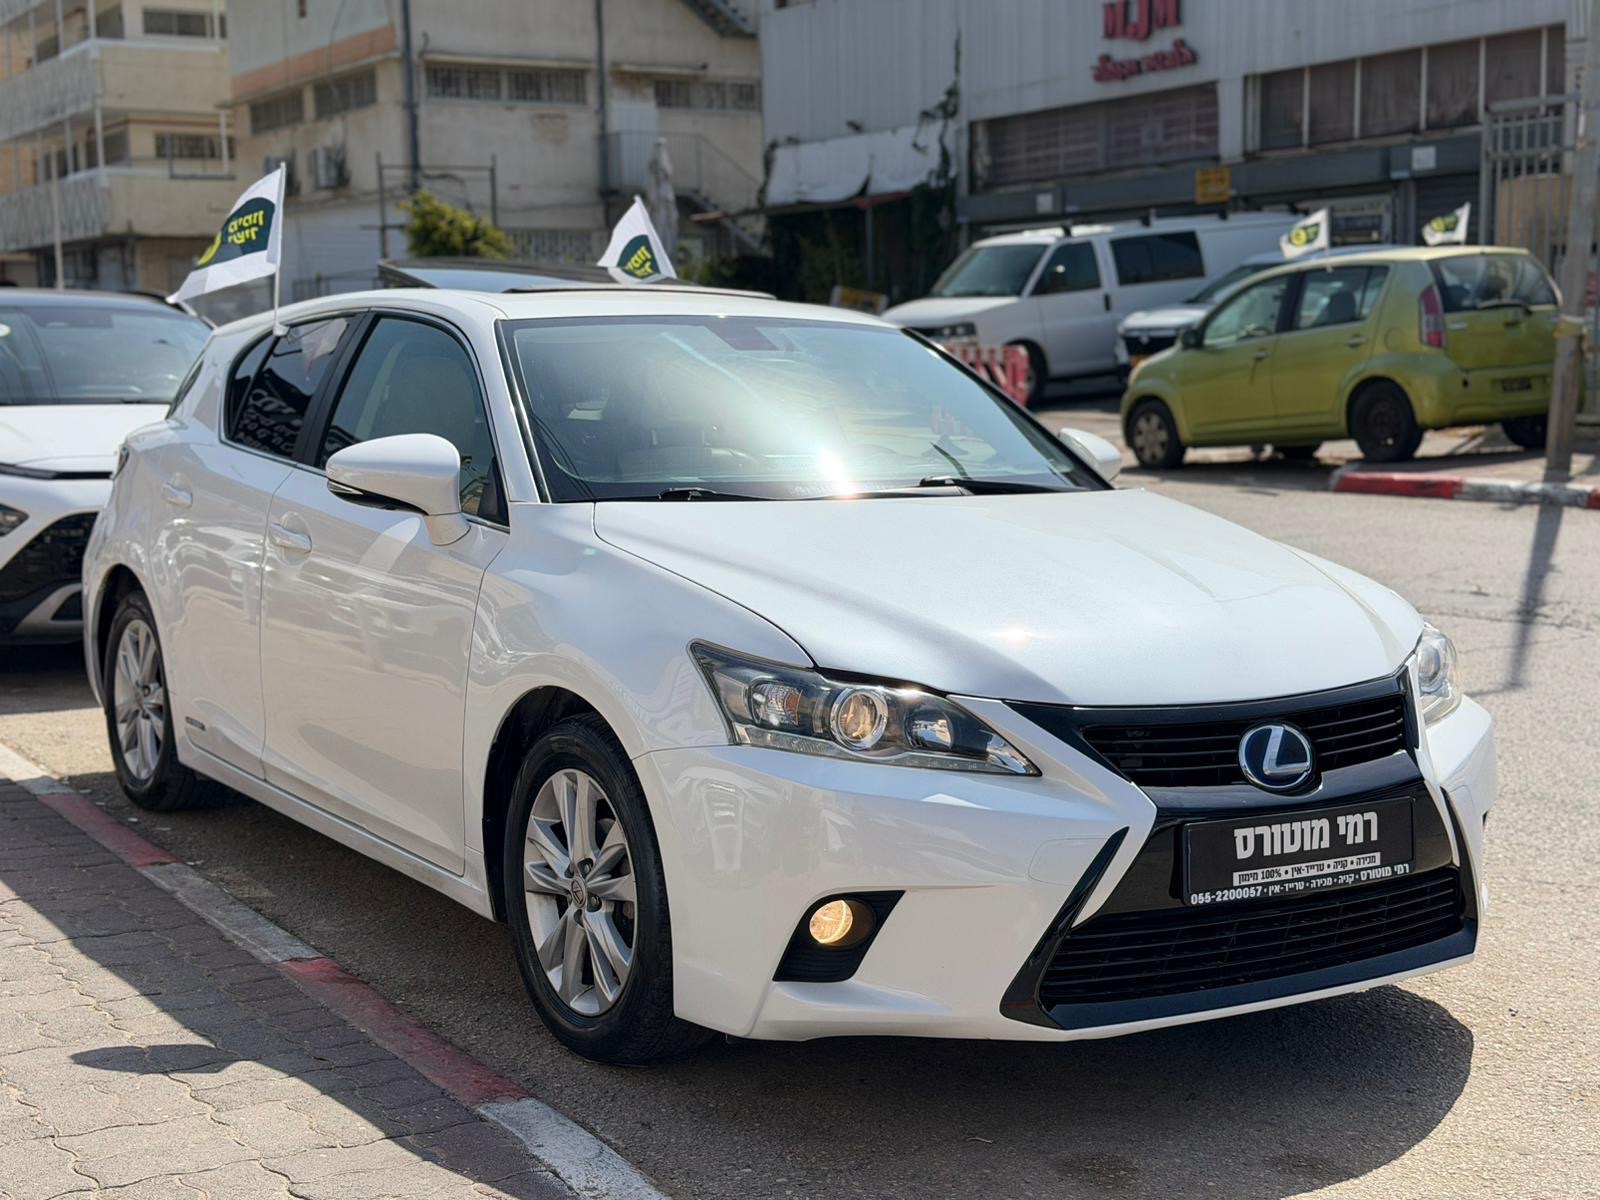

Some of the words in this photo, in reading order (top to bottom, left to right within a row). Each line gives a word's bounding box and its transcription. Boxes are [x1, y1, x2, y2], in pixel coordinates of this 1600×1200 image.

[1336, 811, 1378, 845] רמי
[1233, 817, 1330, 860] מוטורס
[1333, 859, 1348, 872] קניה
[1356, 854, 1376, 866] מכירה
[1261, 868, 1281, 879] 100%
[1360, 866, 1392, 881] מוטורס
[1394, 863, 1409, 875] רמי
[1238, 872, 1258, 885] מימון
[1310, 876, 1333, 889] מכירה
[1338, 873, 1355, 885] קניה
[1190, 886, 1263, 905] 055-2200057
